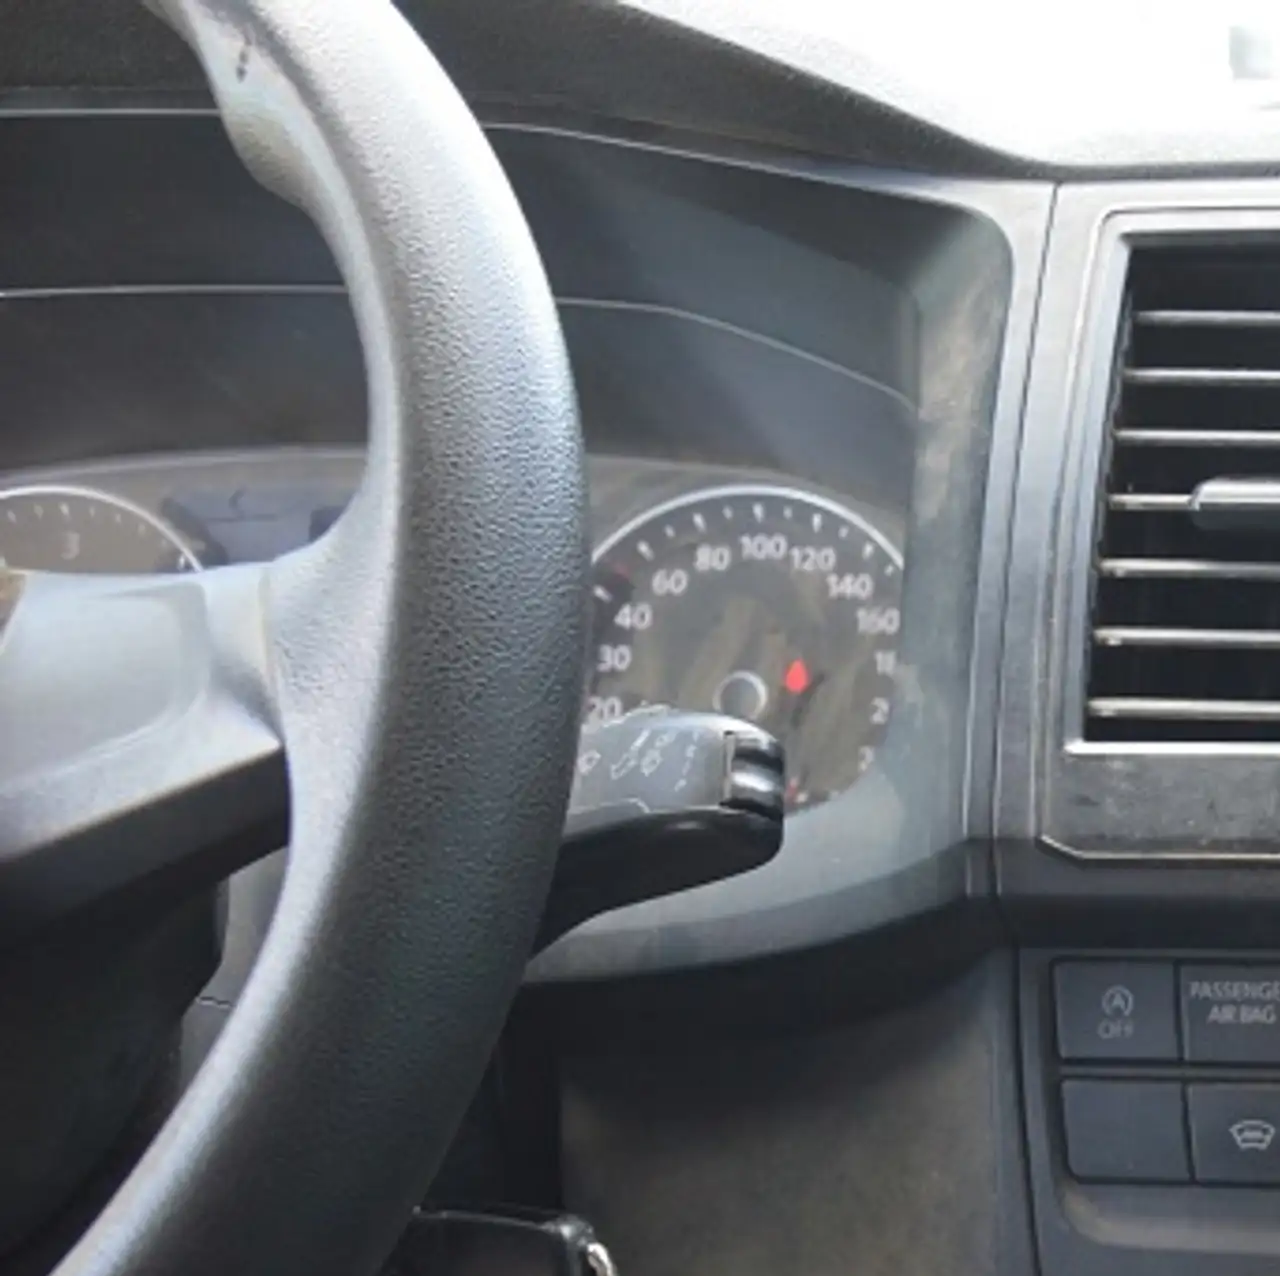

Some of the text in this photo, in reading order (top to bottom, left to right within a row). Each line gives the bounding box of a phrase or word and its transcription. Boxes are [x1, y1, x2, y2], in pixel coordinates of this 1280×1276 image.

[693, 546, 730, 571] 80
[740, 535, 788, 559] 100
[792, 546, 836, 571] 120
[651, 569, 688, 595] 60
[826, 573, 873, 597] 140
[614, 603, 652, 630] 40
[856, 608, 900, 635] 160
[598, 645, 631, 672] 30
